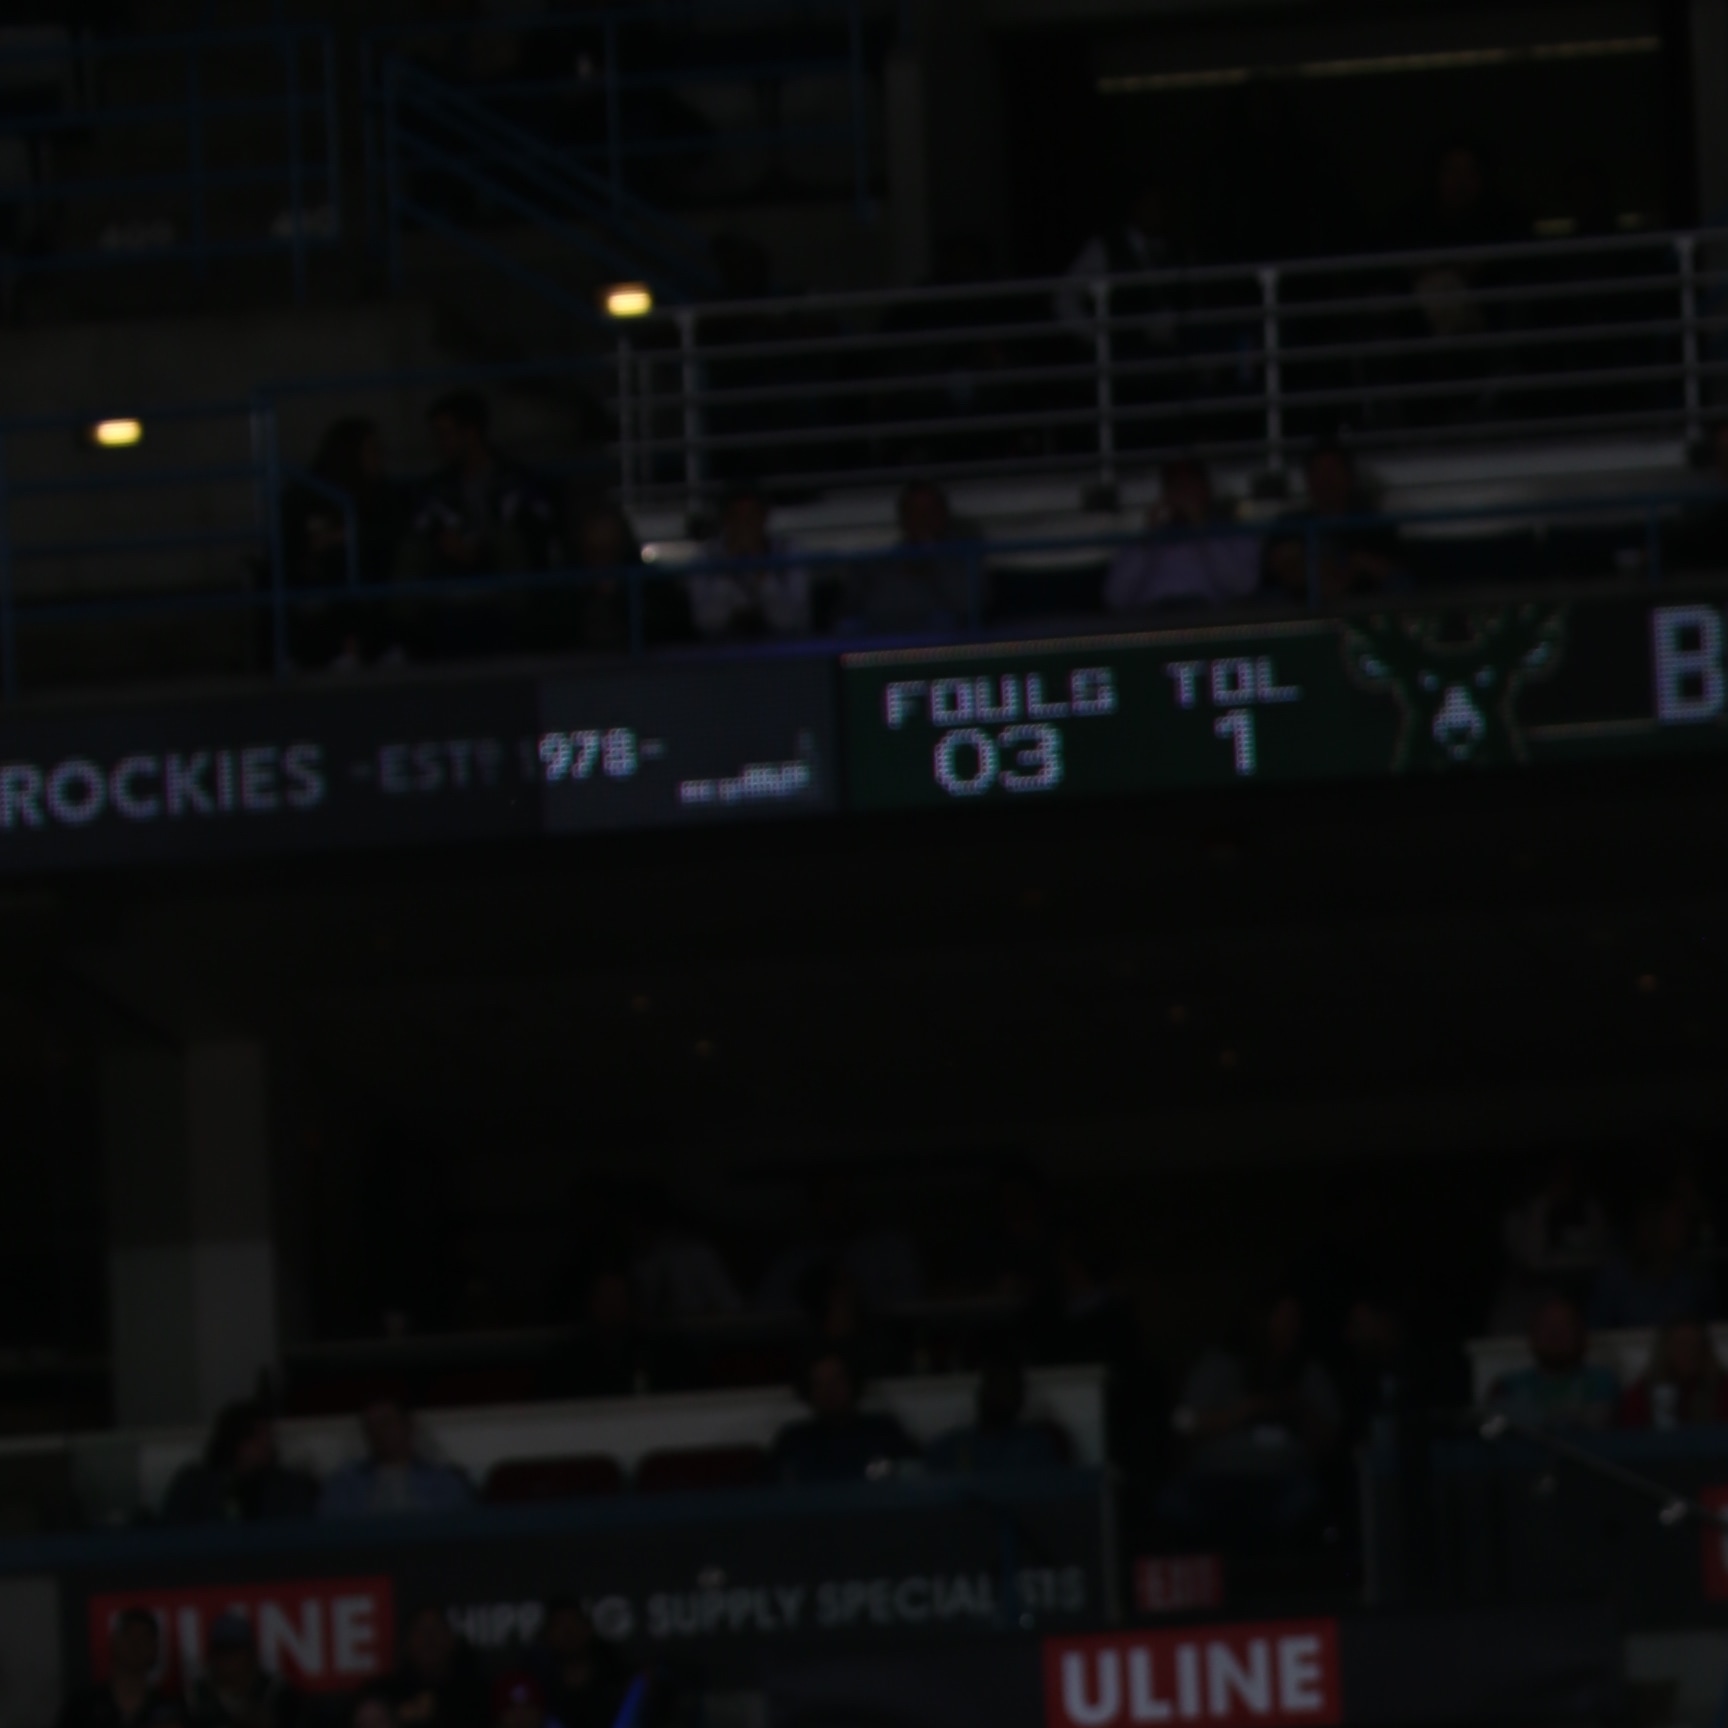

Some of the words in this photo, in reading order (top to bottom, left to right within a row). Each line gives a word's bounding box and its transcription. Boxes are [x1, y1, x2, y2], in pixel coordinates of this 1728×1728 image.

[0, 742, 327, 832] ROCKIES
[935, 723, 1064, 797] 03
[1214, 708, 1257, 777] 1
[648, 1584, 804, 1638] SUPPLY
[815, 1566, 1086, 1629] SPECIALSTS
[1058, 1634, 1329, 1728] ULINE
